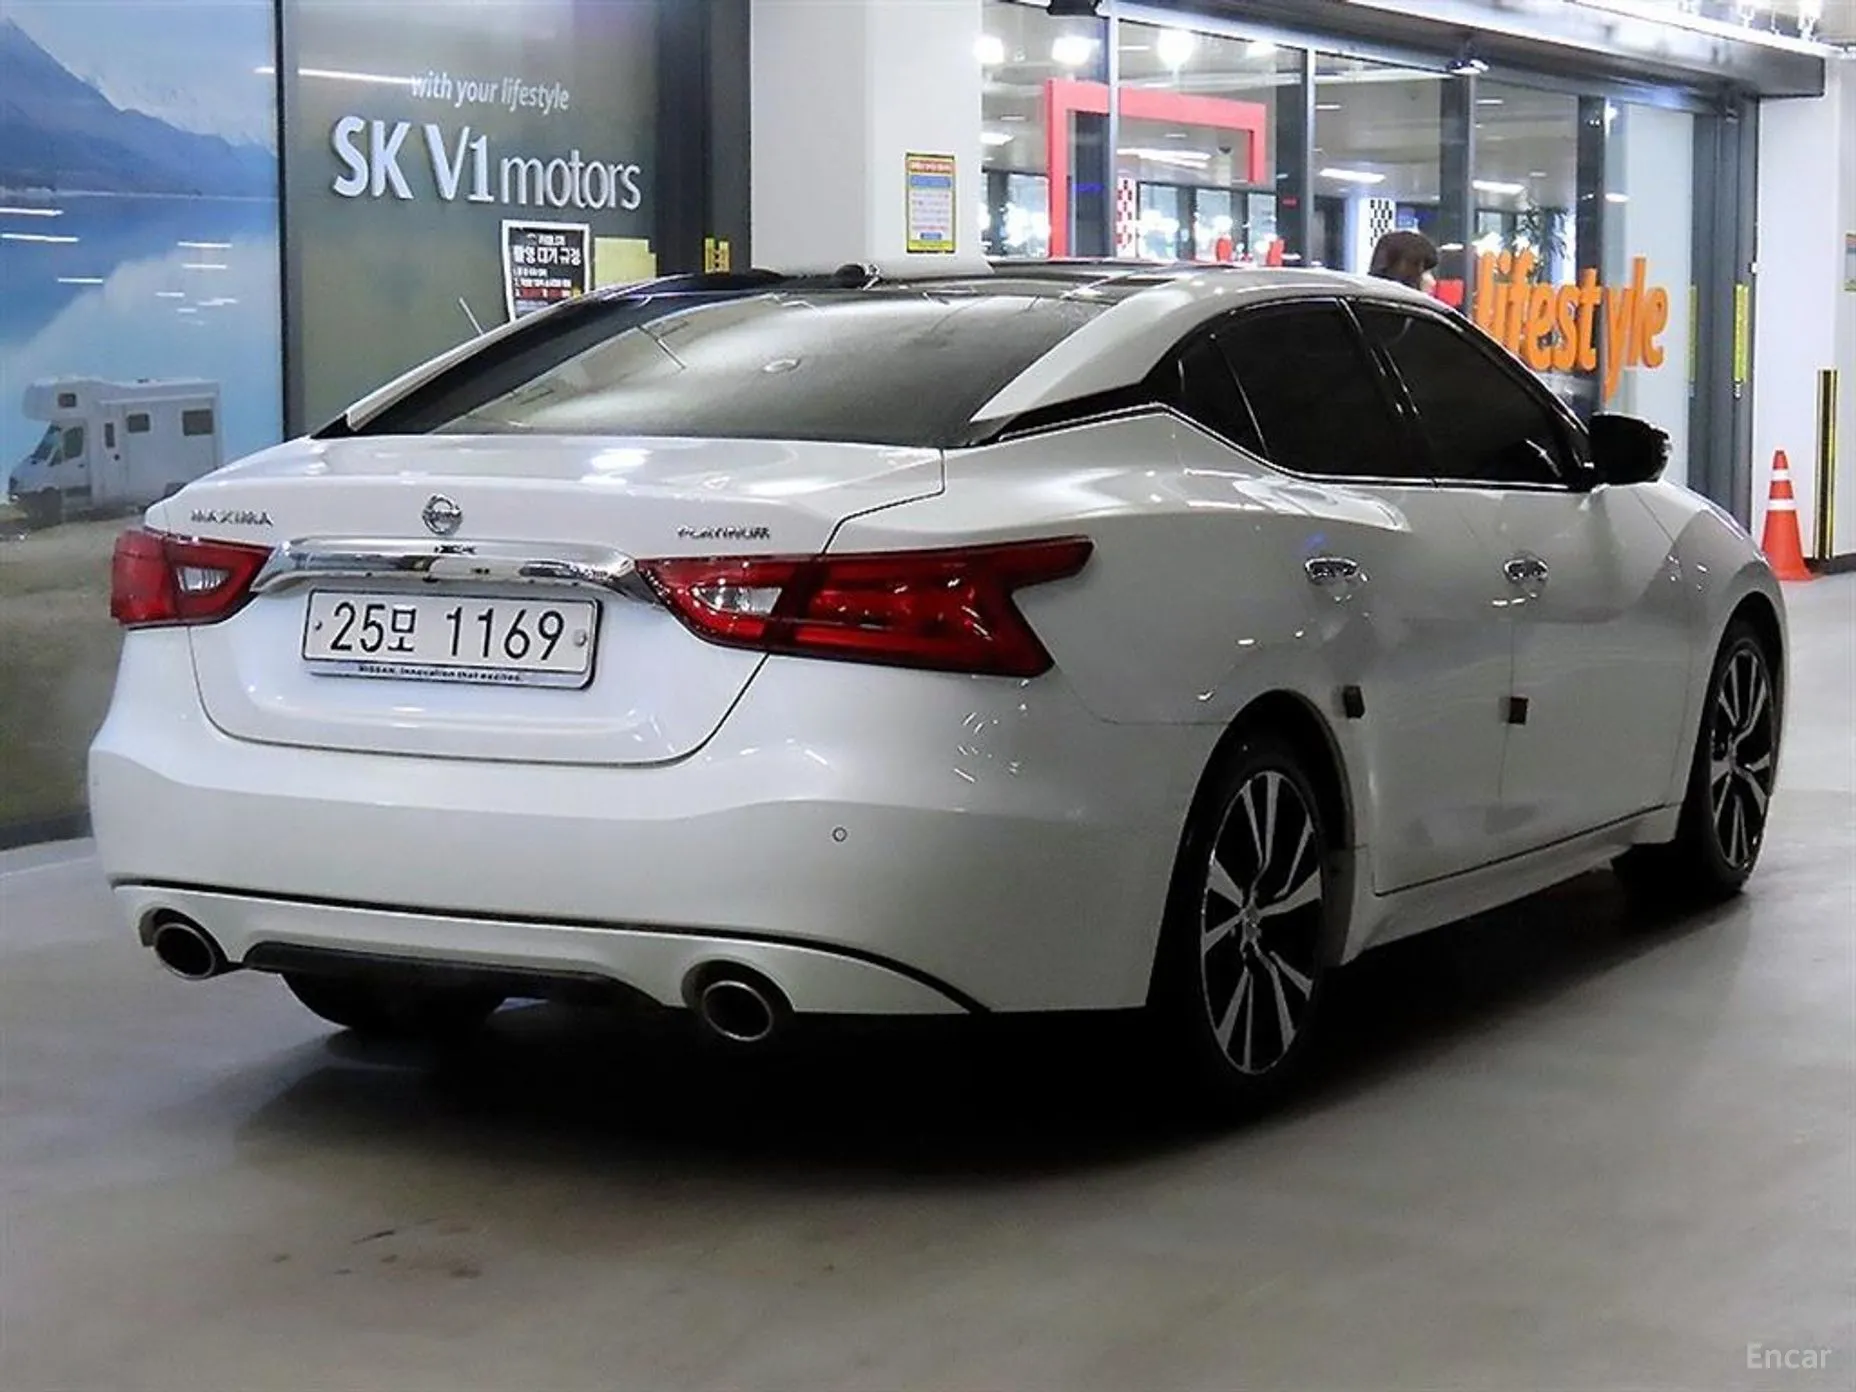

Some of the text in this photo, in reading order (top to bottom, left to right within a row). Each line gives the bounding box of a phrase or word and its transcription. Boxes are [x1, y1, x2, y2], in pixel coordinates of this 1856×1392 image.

[411, 70, 569, 115] with your lifestyle
[333, 115, 641, 210] SK V1 motors
[1475, 250, 1668, 406] lifestyle
[190, 510, 274, 527] MAXIMA
[330, 601, 565, 662] 25모 1169
